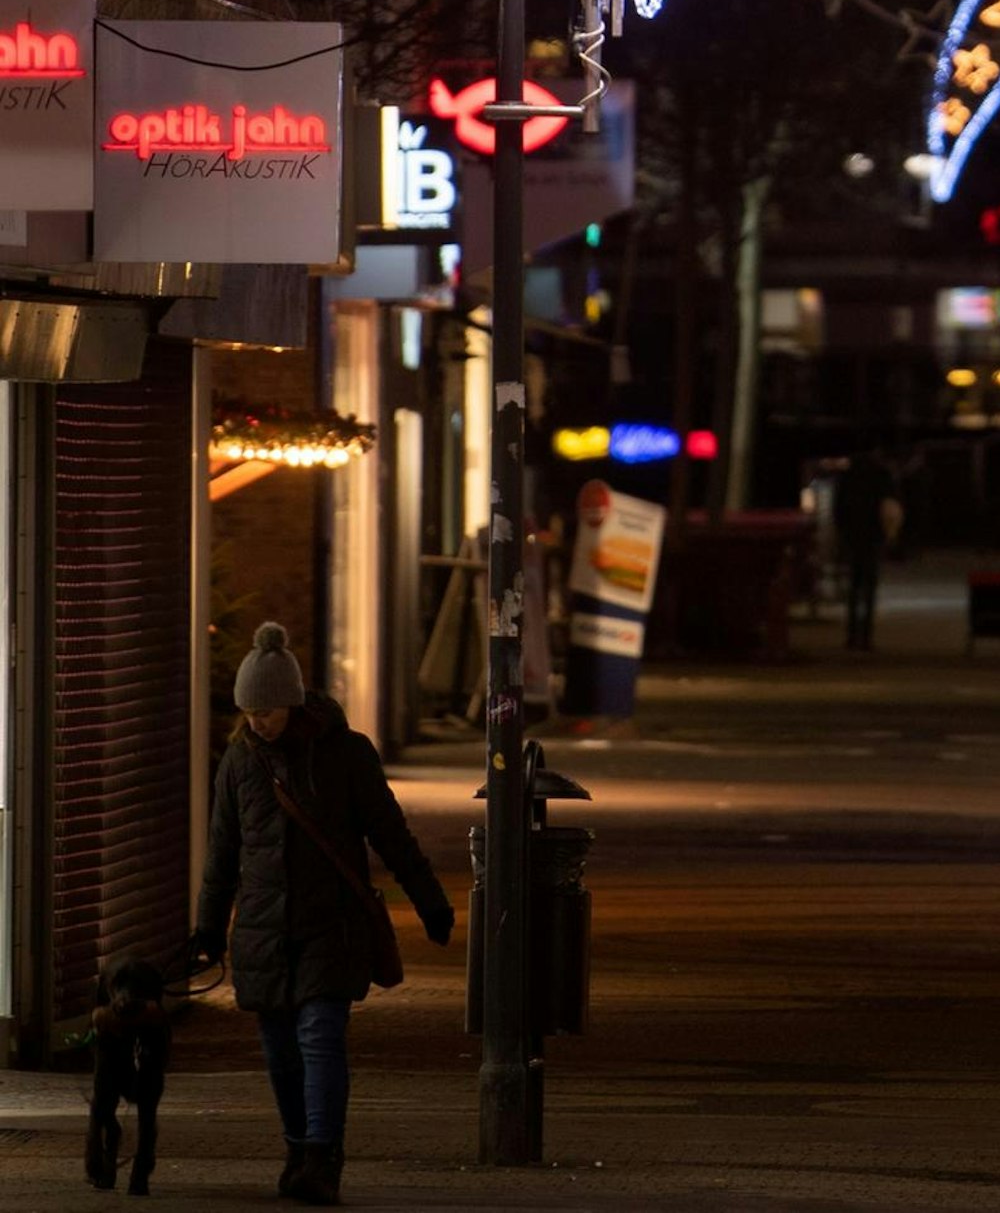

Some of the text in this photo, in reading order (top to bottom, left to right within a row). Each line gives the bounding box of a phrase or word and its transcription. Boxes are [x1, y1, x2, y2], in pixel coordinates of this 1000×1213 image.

[0, 80, 72, 110] STIK
[109, 104, 327, 160] optik jahn
